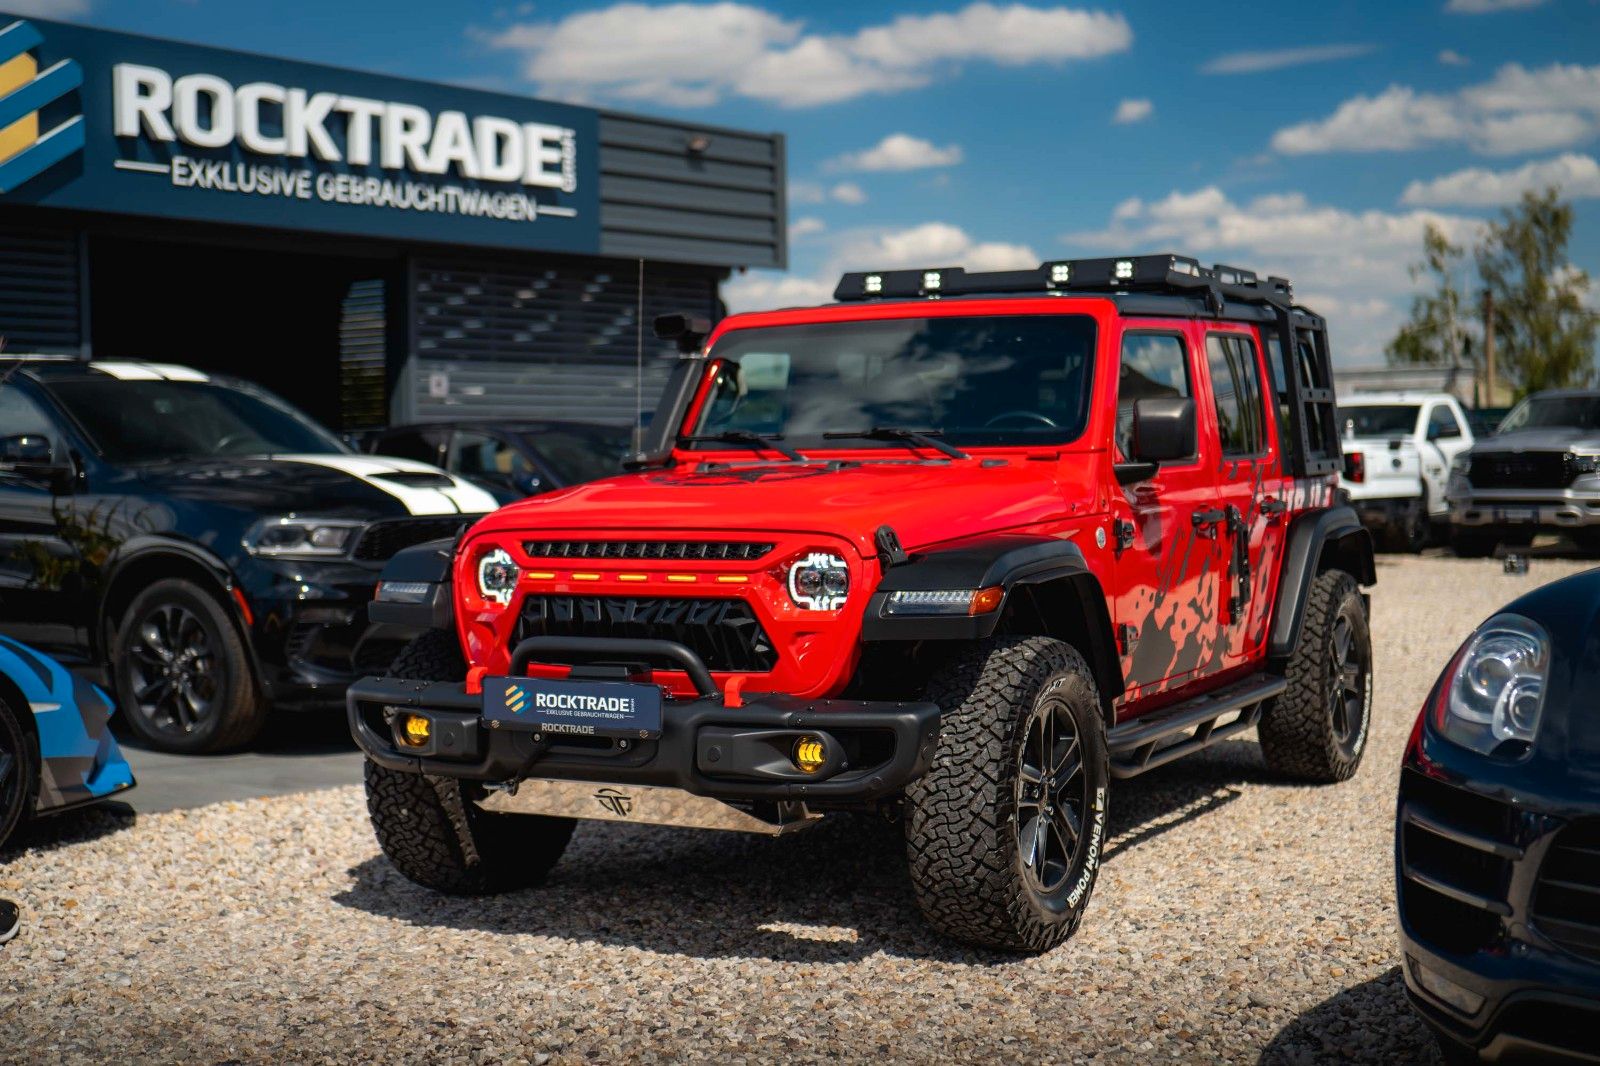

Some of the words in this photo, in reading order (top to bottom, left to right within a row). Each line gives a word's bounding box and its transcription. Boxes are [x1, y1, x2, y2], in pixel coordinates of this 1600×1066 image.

[113, 63, 565, 189] ROCKTRADE
[172, 155, 312, 200] EXKLUSIVE
[316, 172, 536, 221] GEBRAUCHTWAGEN
[536, 693, 629, 712] ROCKTRADE
[546, 709, 572, 717] EXKLUSIVE
[574, 711, 624, 719] GEBRAUCHTWAGEN
[541, 722, 594, 735] ROCKTRADE
[1085, 812, 1104, 870] VENOM
[1067, 868, 1090, 909] POWER
